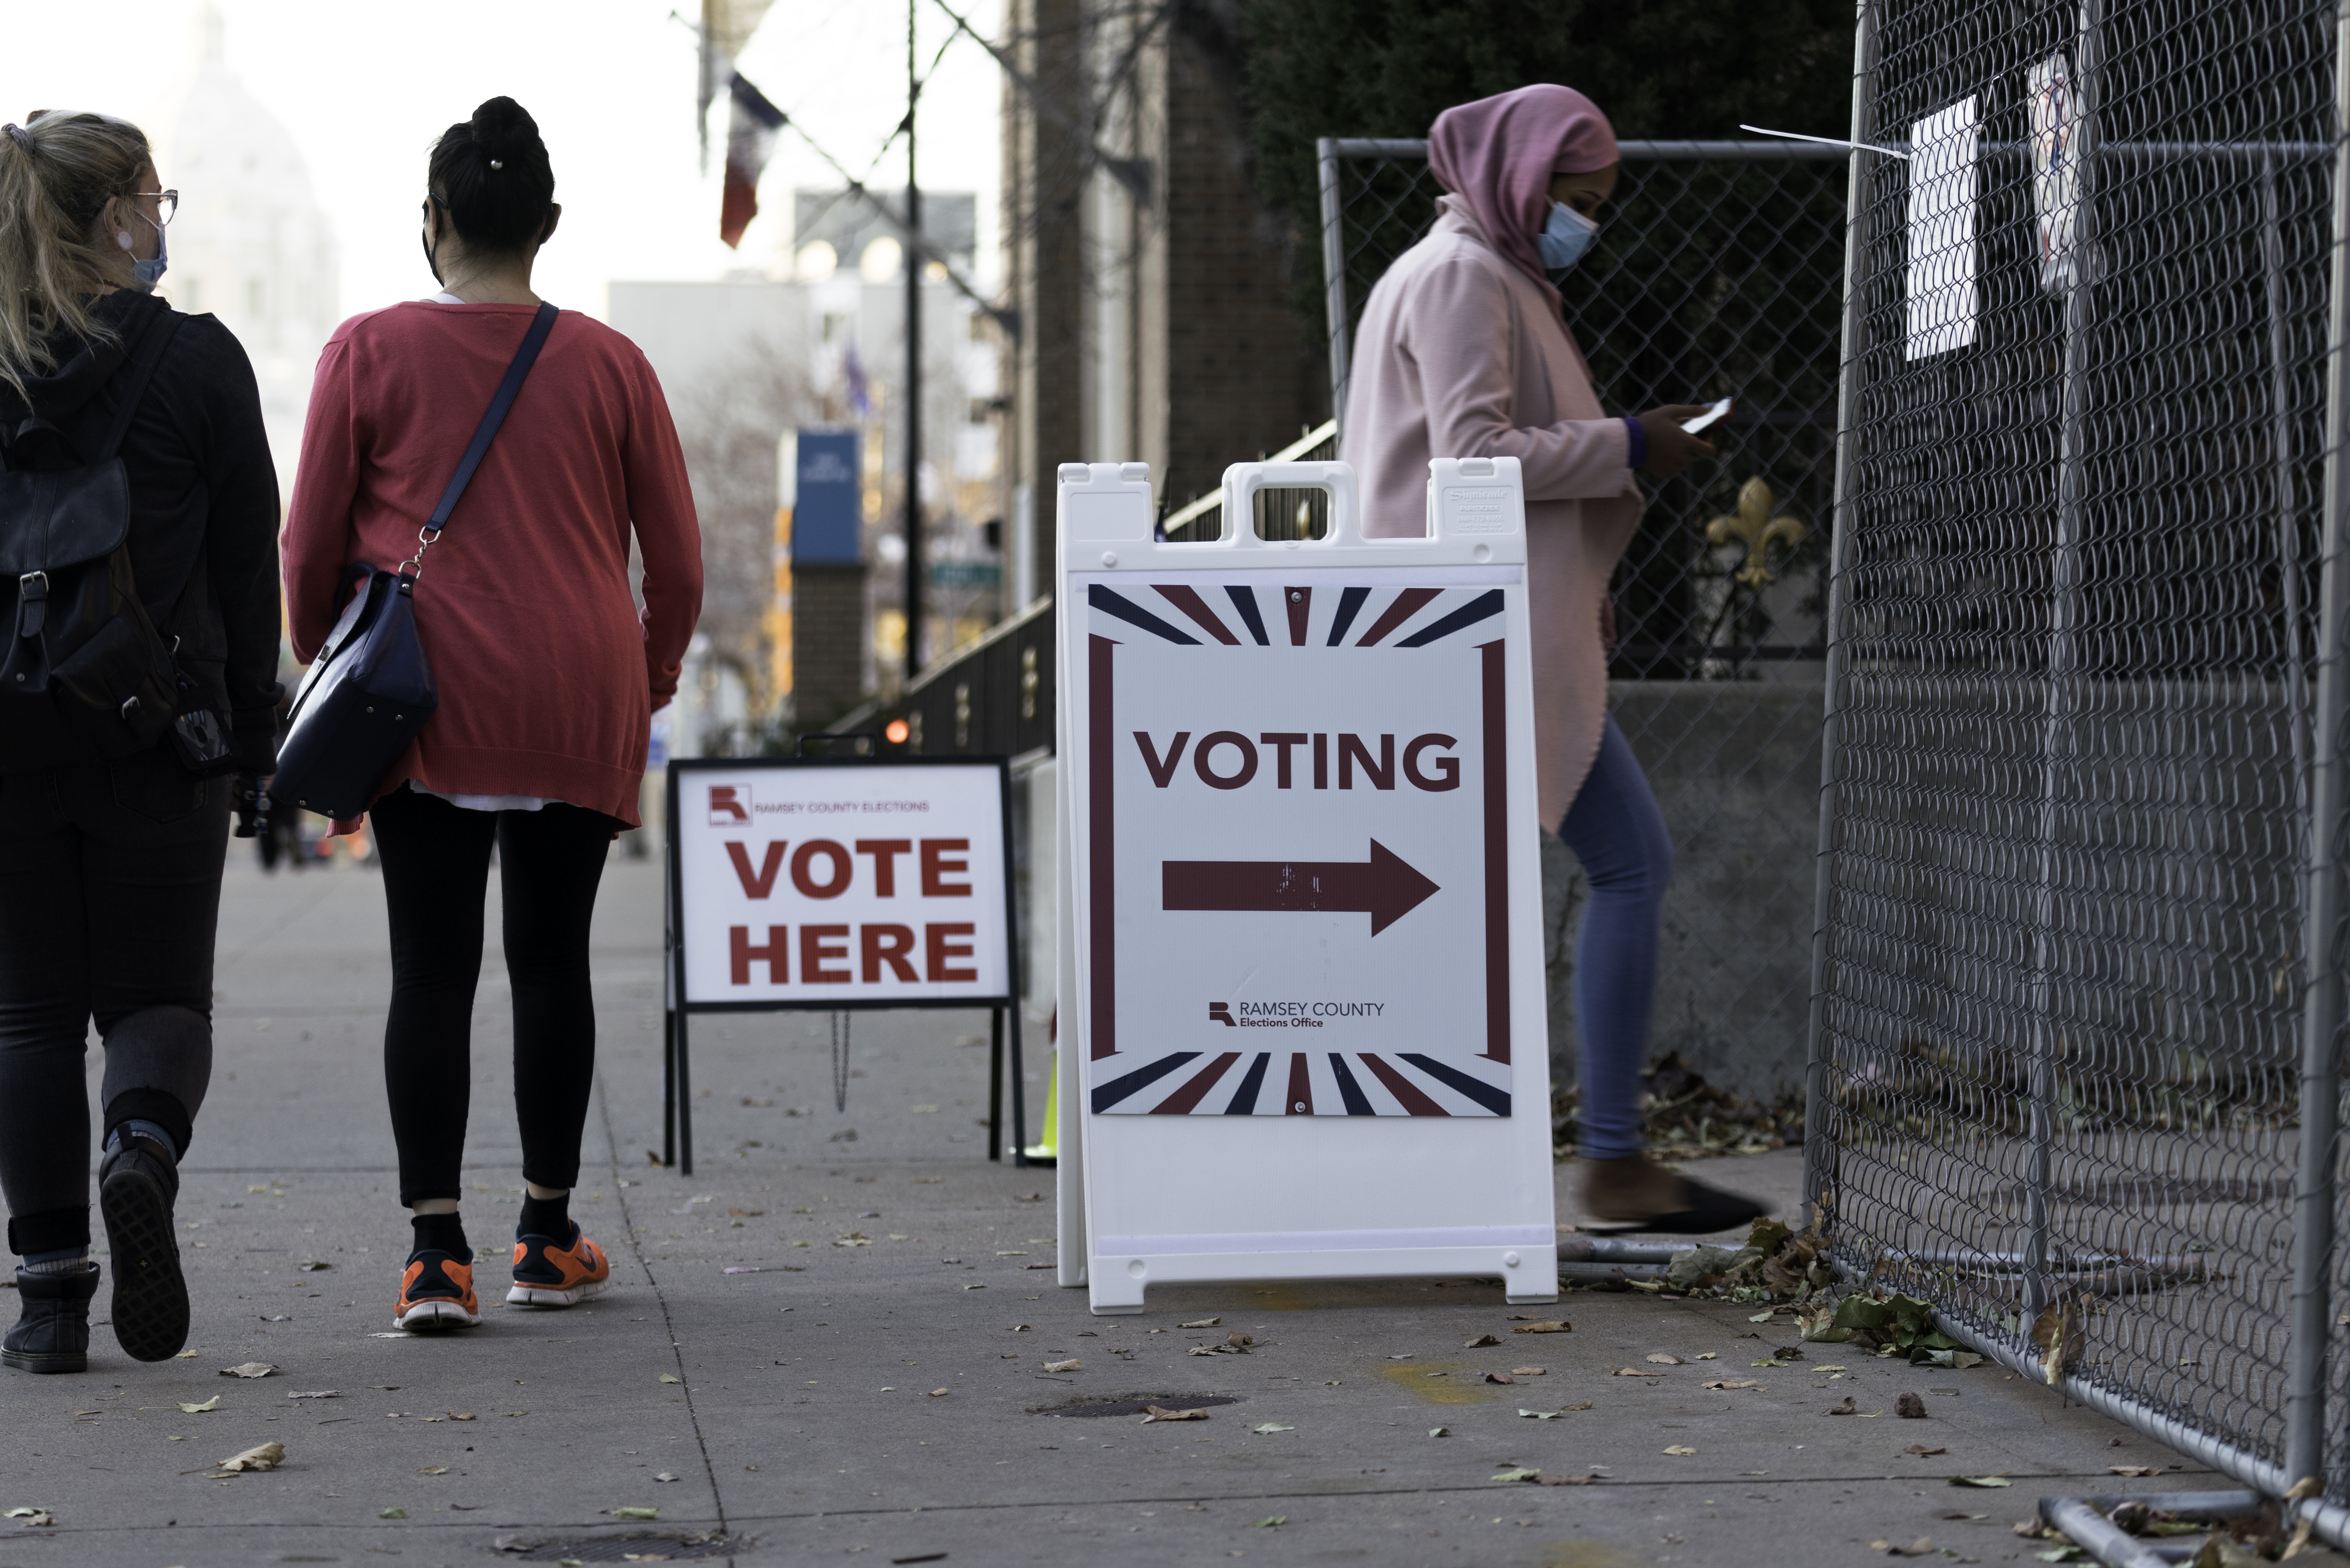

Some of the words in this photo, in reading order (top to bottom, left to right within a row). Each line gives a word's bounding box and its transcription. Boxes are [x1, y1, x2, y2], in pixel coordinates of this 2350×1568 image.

[1450, 488, 1507, 502] Signicade
[1133, 731, 1460, 792] VOTING
[755, 803, 805, 814] RAMSEY
[808, 802, 859, 814] COUNTY
[862, 801, 930, 813] ELECTIONS
[725, 838, 973, 900] VOTE
[730, 922, 978, 986] HERE
[1240, 1002, 1308, 1016] RAMSEY
[1313, 1003, 1385, 1016] COUNTY
[1240, 1017, 1288, 1027] Elections
[1291, 1017, 1324, 1027] Office
